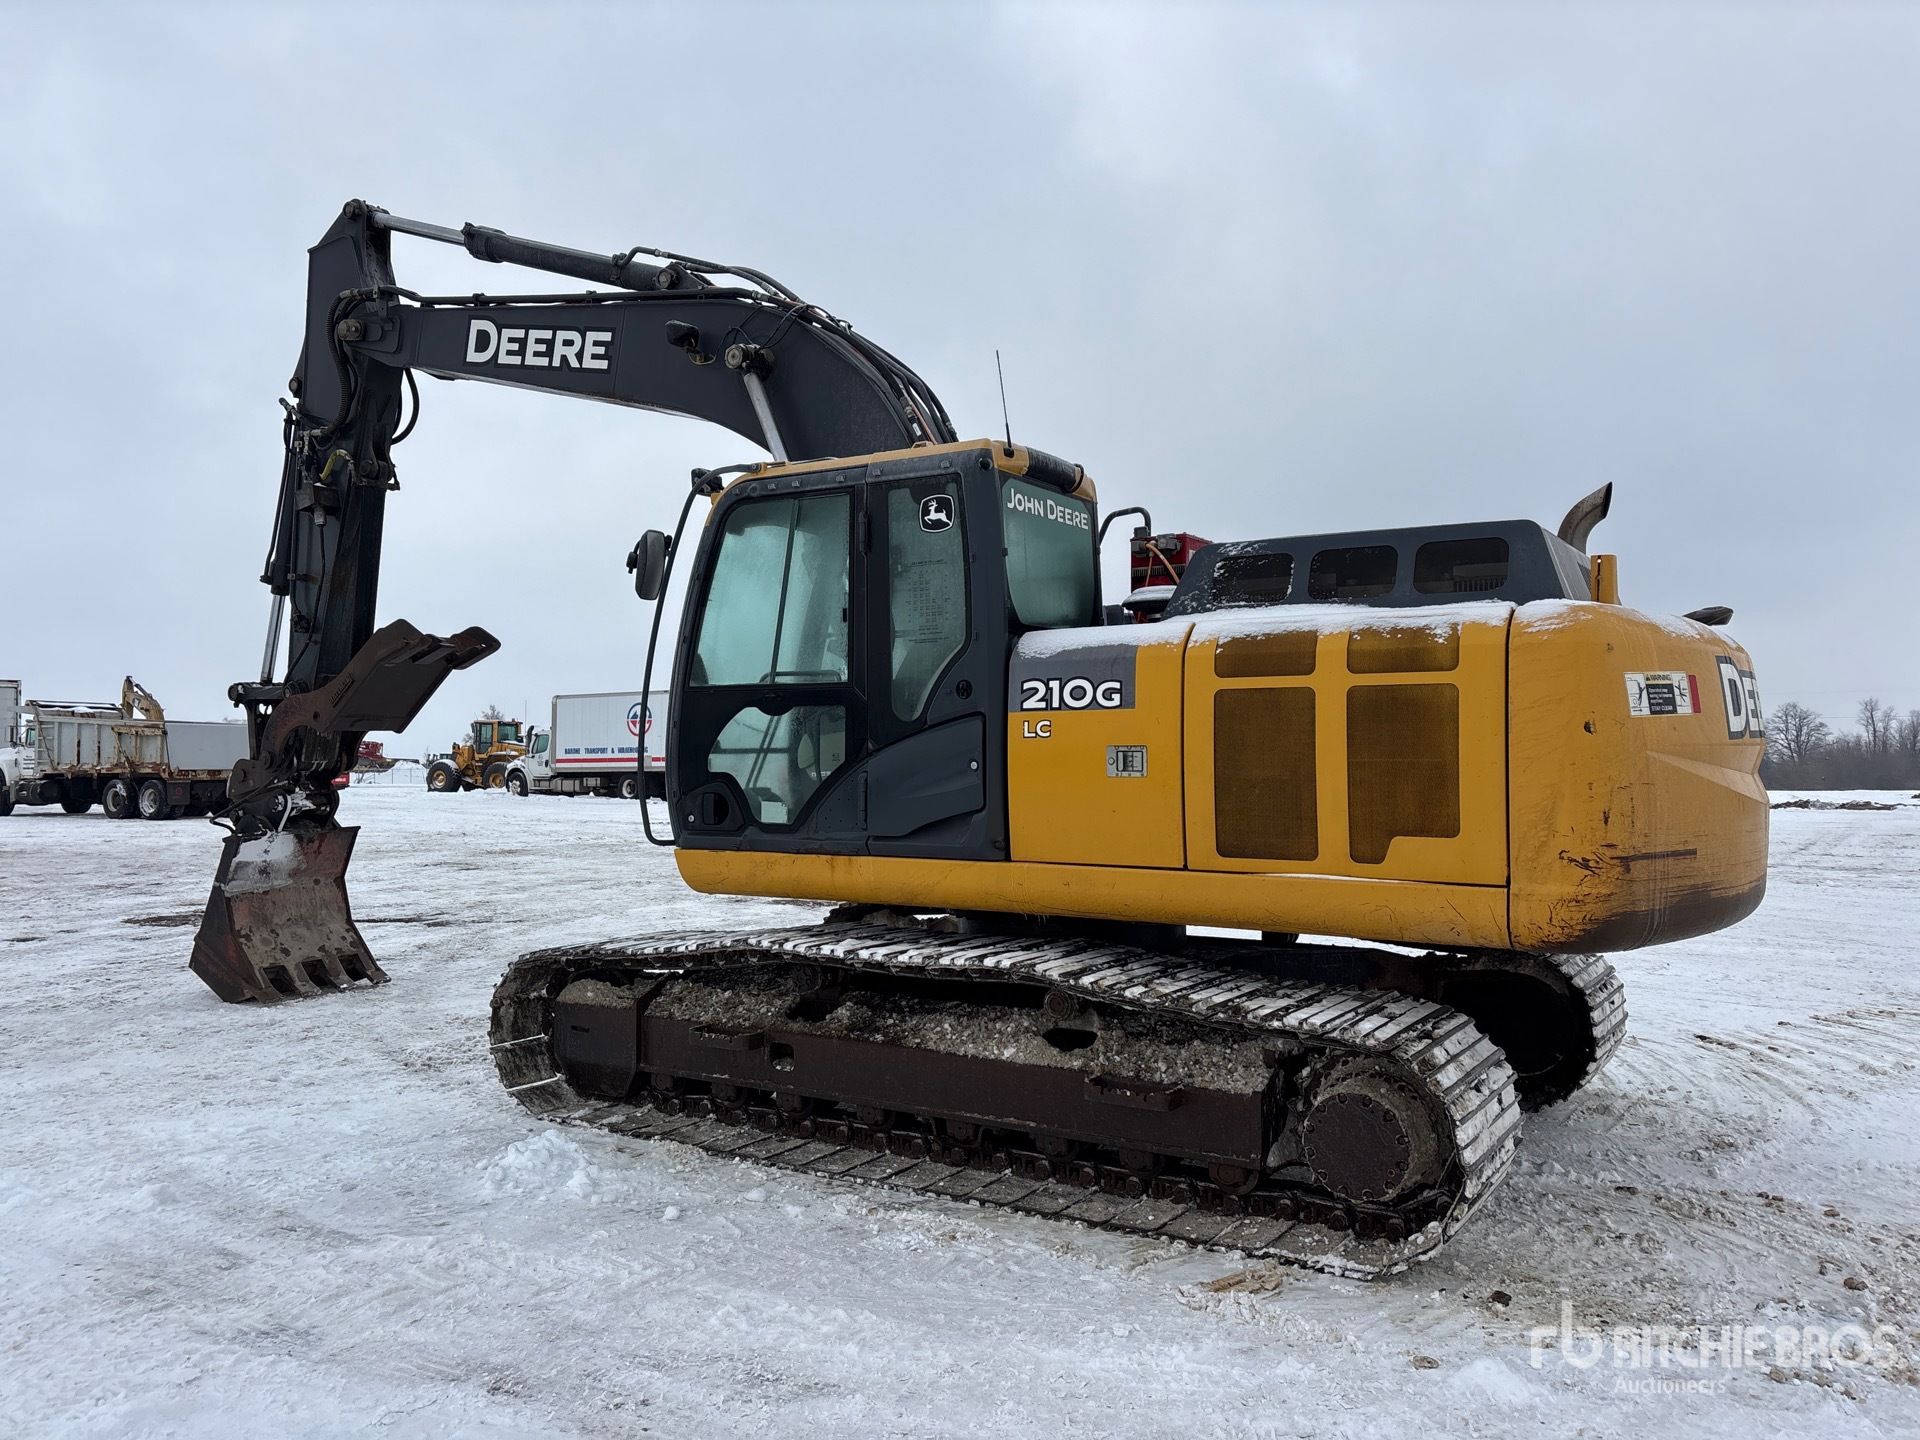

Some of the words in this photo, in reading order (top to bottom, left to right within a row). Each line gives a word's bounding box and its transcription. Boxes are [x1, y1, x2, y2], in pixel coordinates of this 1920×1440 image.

[466, 319, 613, 370] DEERE
[1007, 488, 1044, 517] JOHN
[1047, 499, 1089, 530] DEERE
[1021, 677, 1122, 711] 210G
[1023, 720, 1051, 738] LC
[584, 747, 608, 755] TRANSPORT
